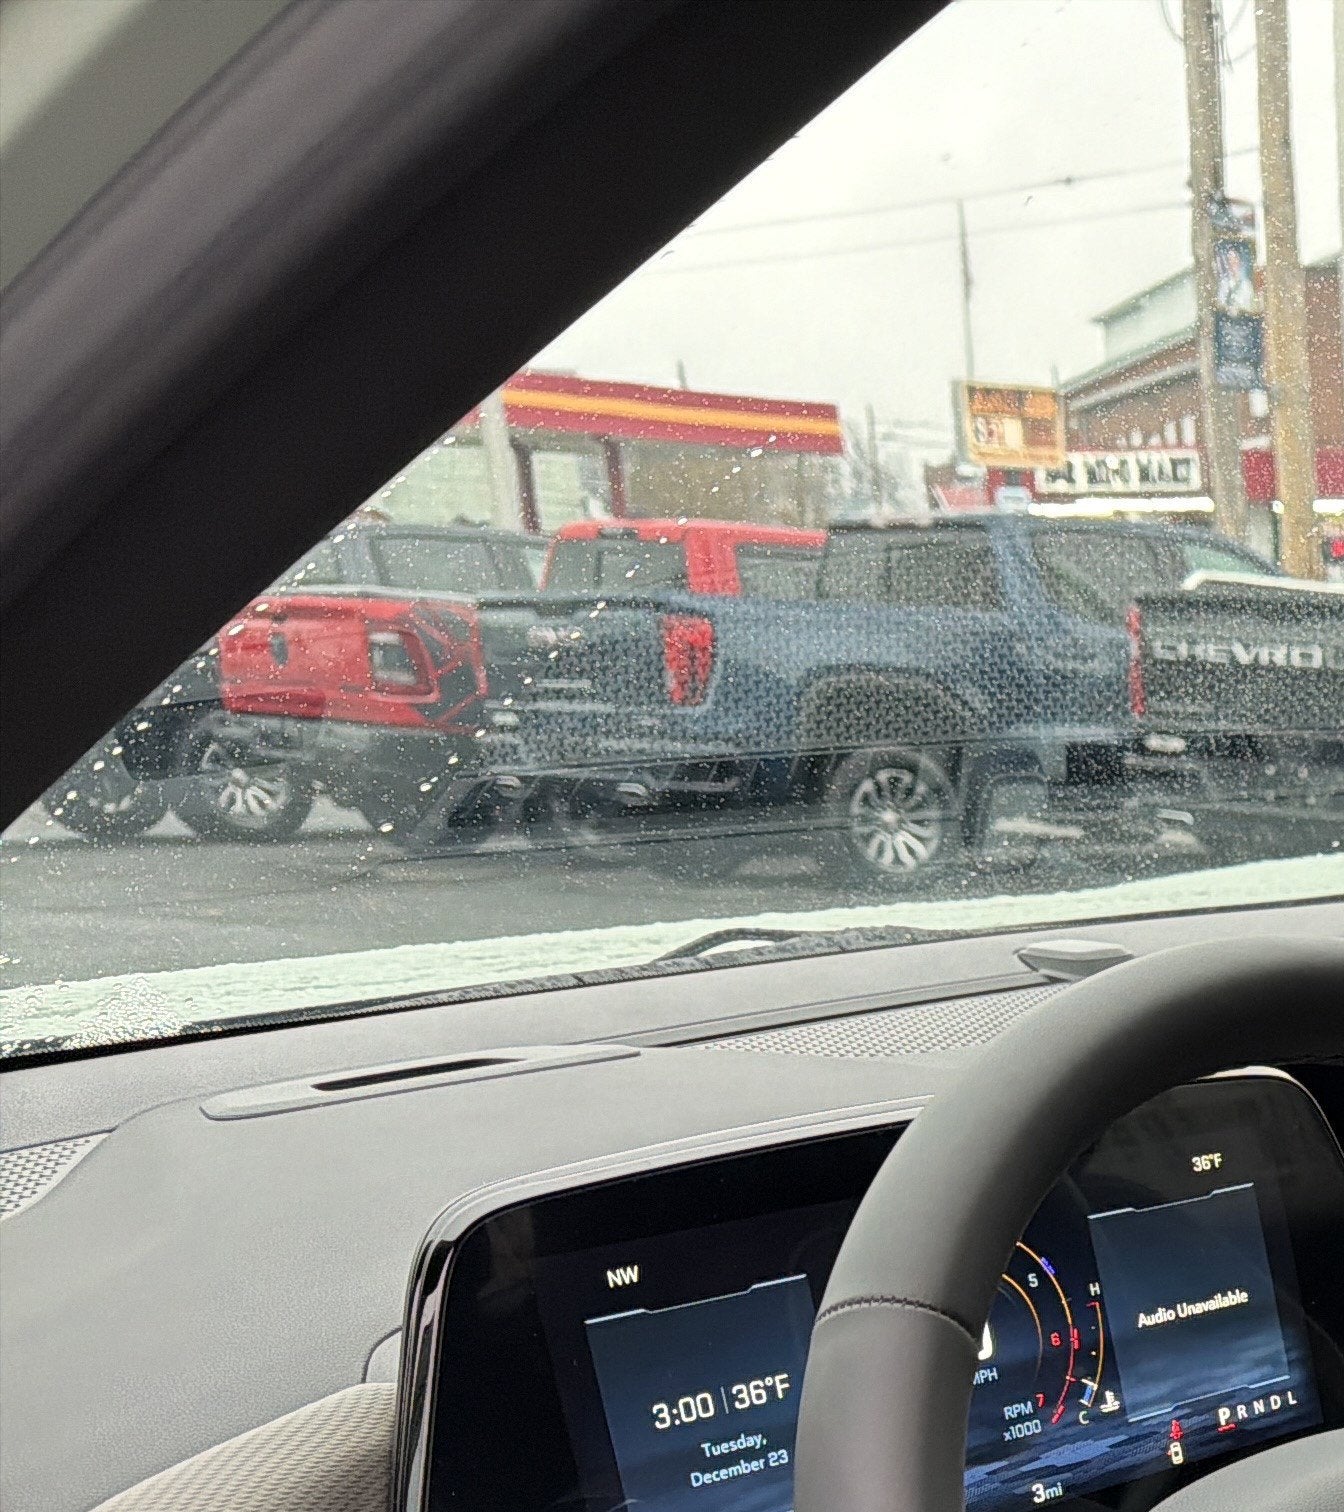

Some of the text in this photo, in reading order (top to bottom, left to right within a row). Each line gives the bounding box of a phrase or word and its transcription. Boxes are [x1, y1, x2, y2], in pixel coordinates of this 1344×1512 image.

[606, 1264, 640, 1289] NW
[1028, 1273, 1039, 1288] 5
[1089, 1281, 1100, 1297] H
[1138, 1288, 1249, 1328] Audio Unavailable
[1050, 1332, 1061, 1346] 6
[653, 1373, 791, 1429] 3:00 36°F
[1003, 1400, 1033, 1420] RPM
[1035, 1393, 1045, 1408] 7
[1218, 1391, 1297, 1426] P R N D L
[1078, 1410, 1089, 1425] C
[1003, 1419, 1041, 1442] x1000
[700, 1432, 768, 1458] Tuesday,
[690, 1449, 789, 1488] December 23
[1031, 1481, 1063, 1504] 3mi
